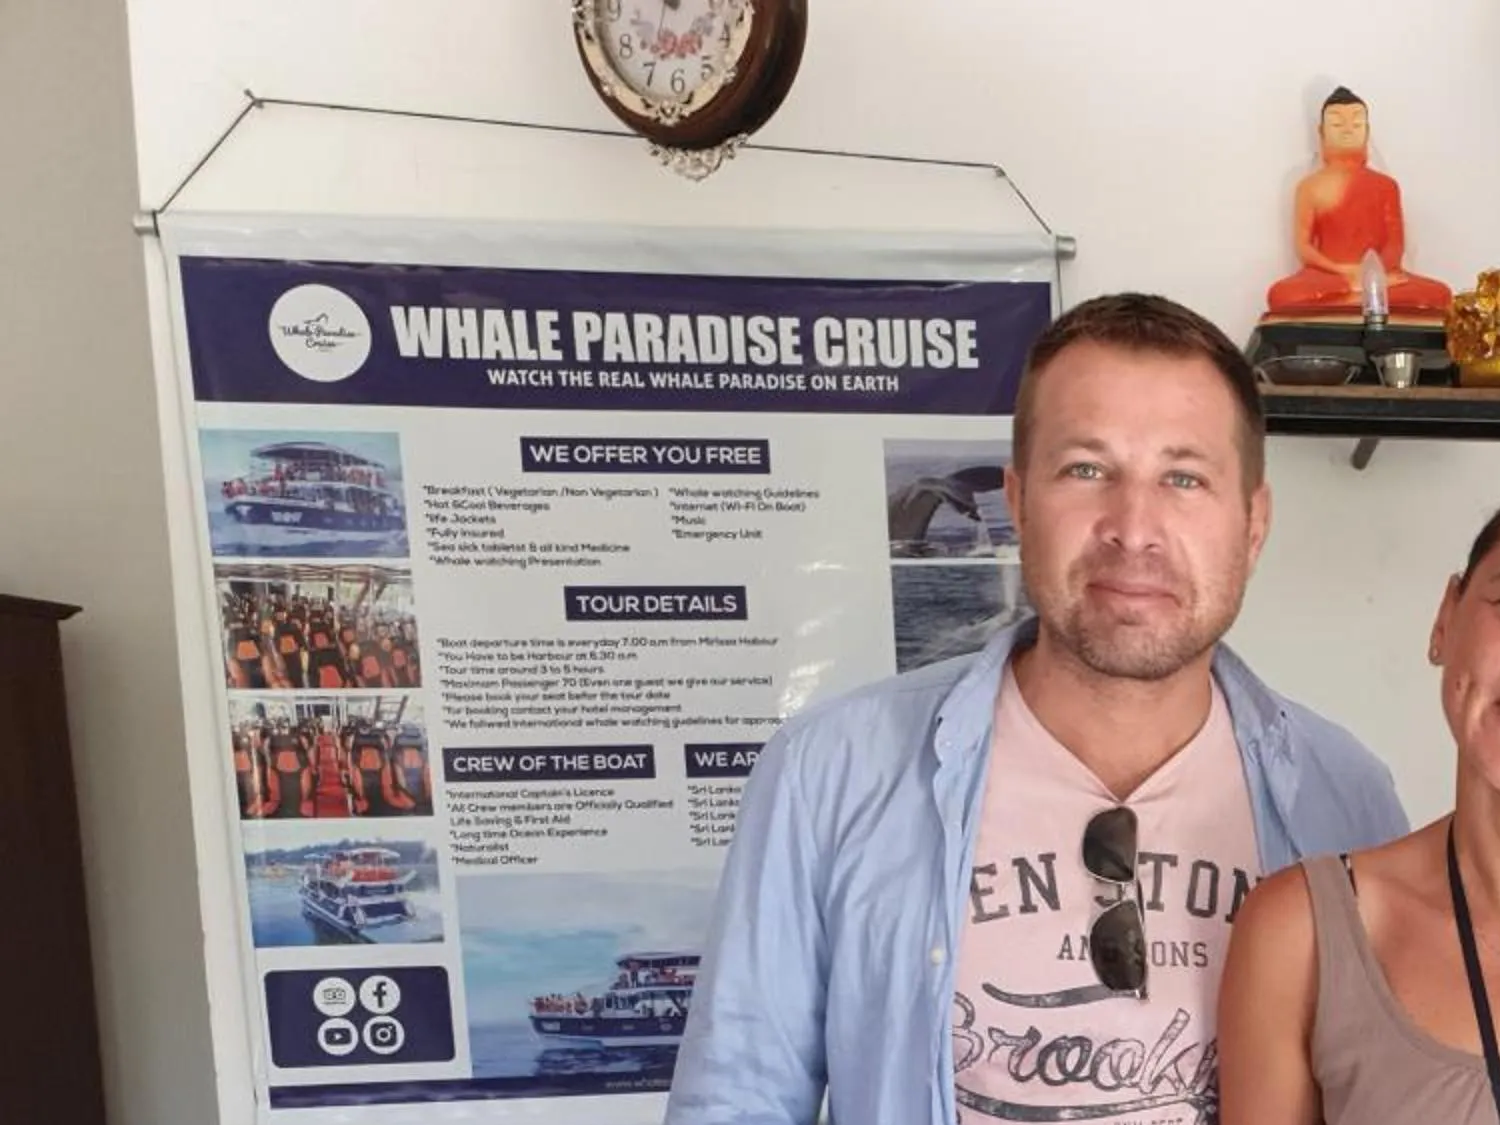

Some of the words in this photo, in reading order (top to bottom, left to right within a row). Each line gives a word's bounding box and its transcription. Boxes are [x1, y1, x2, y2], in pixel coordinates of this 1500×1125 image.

[618, 33, 633, 59] 8
[643, 61, 656, 87] 7
[670, 68, 685, 94] 6
[390, 305, 563, 361] WHALE
[572, 311, 803, 366] PARADISE
[813, 316, 979, 368] CRUISE
[487, 368, 553, 386] WATCH
[557, 370, 594, 387] THE
[599, 371, 645, 388] REAL
[649, 372, 714, 389] WHALE
[719, 373, 806, 390] PARADISE
[811, 375, 838, 390] ON
[842, 375, 899, 391] EARTH
[529, 445, 569, 463] WE
[573, 446, 649, 464] OFFER
[654, 446, 701, 464] YOU
[706, 447, 761, 464] FREE
[575, 595, 640, 613] TOUR
[644, 595, 738, 613] DETAILS
[453, 756, 515, 772] CREW
[519, 755, 547, 771] OF
[550, 754, 590, 771] THE
[593, 753, 647, 769] BOAT
[694, 751, 728, 767] WE
[731, 751, 760, 767] AR
[1057, 934, 1092, 961] AN
[1151, 941, 1209, 968] ONS
